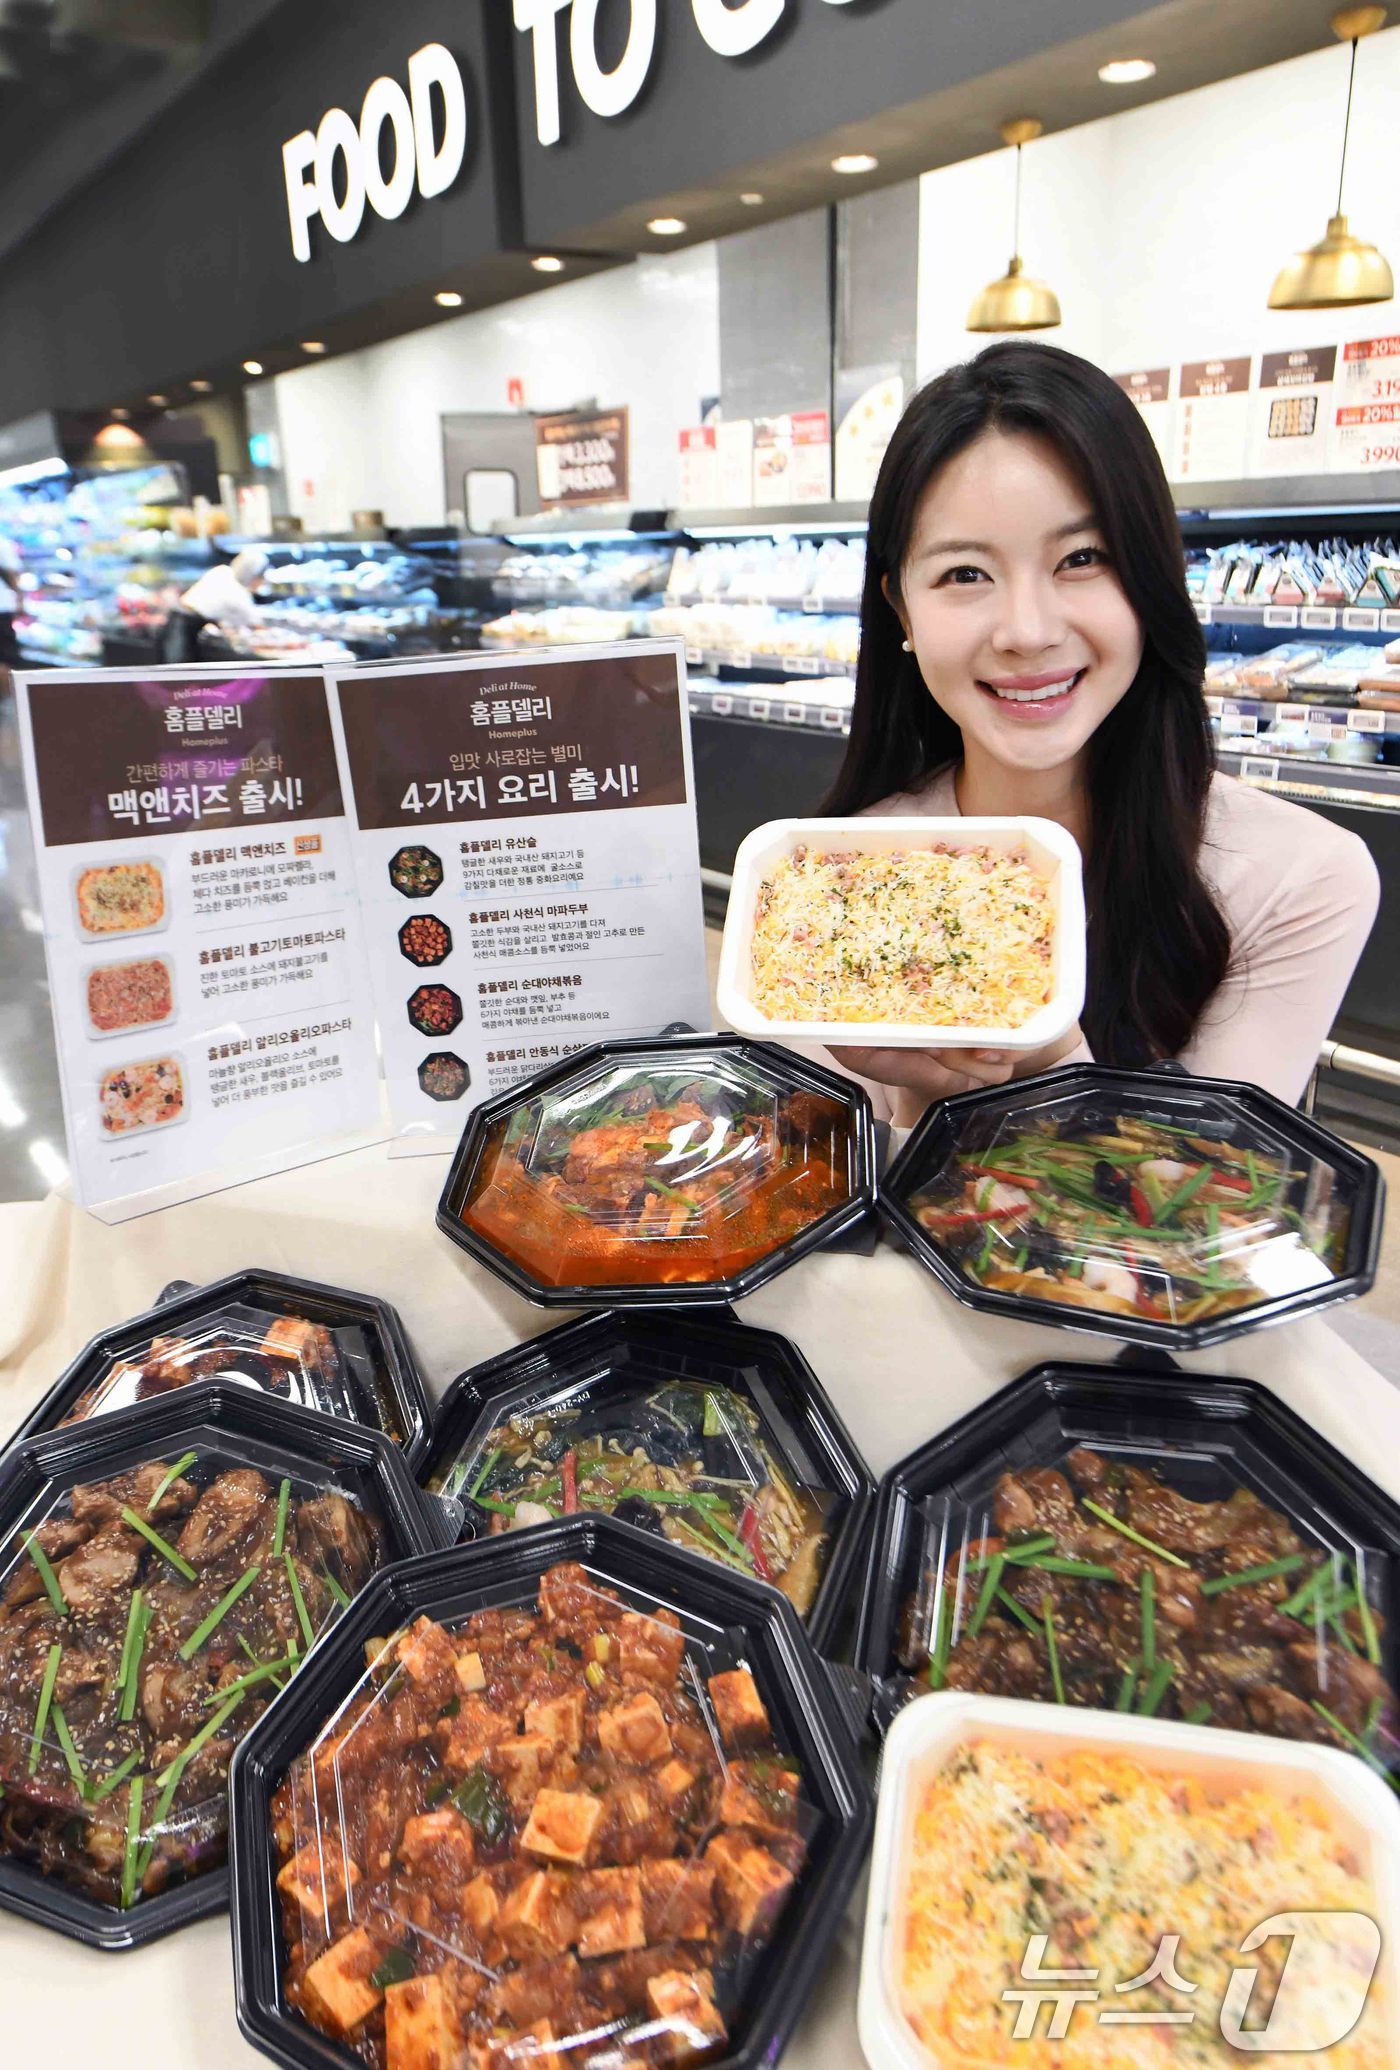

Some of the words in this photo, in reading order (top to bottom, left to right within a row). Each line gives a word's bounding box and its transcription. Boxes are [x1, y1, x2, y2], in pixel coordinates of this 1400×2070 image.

[281, 42, 467, 263] FOOD
[513, 0, 656, 146] TO
[480, 683, 497, 696] Deli
[498, 683, 508, 691] at
[509, 681, 537, 692] Home
[164, 704, 243, 733] 홈플델리
[470, 696, 552, 726] 홈플델리
[181, 736, 228, 747] Homeplus
[488, 728, 538, 739] Homeplus
[449, 752, 480, 772] 입맛
[485, 747, 547, 769] 사로잡는
[551, 743, 582, 763] 별미
[126, 761, 189, 784] 간편하게
[192, 758, 237, 779] 즐기는
[240, 754, 283, 773] 파스타
[400, 776, 486, 814] 4가지
[497, 770, 557, 804] 요리
[568, 764, 639, 802] 출시!
[108, 784, 231, 826] 맥앤치즈
[239, 776, 303, 816] 출시!
[191, 847, 237, 866] 홈플델리
[240, 841, 286, 860] 맥앤치즈
[459, 839, 502, 854] 홈플델리
[505, 836, 537, 850] 유산슬
[461, 858, 485, 868] 탱글한
[488, 856, 512, 866] 새우와
[514, 853, 539, 863] 국내산
[541, 850, 574, 860] 돼지고기
[576, 849, 584, 859] 등
[191, 870, 227, 883] 부드러운
[230, 864, 275, 880] 마카로니에
[462, 869, 484, 879] 9가지
[486, 866, 519, 877] 다채로운
[521, 864, 546, 874] 재료에
[550, 861, 583, 872] 굴소스로
[214, 883, 240, 895] 치즈를
[318, 870, 336, 882] 더해
[464, 879, 496, 891] 감칠맛을
[498, 878, 515, 887] 더한
[517, 876, 533, 886] 정통
[194, 901, 221, 914] 고소한
[224, 897, 251, 911] 풍미가
[253, 891, 288, 906] 가득해요
[468, 909, 510, 924] 홈플델리
[513, 906, 544, 920] 사천식
[547, 903, 589, 917] 마파두부
[471, 927, 494, 937] 고소한
[497, 925, 520, 935] 두부와
[522, 923, 546, 933] 국내산
[548, 919, 587, 931] 돼지고기를
[589, 918, 606, 928] 다져
[472, 938, 495, 949] 쫄깃한
[498, 935, 521, 947] 식감을
[523, 933, 547, 945] 살리고
[551, 931, 583, 942] 발효콩과
[585, 929, 601, 939] 절인
[603, 927, 627, 938] 고추로
[629, 926, 646, 936] 만든
[199, 944, 245, 965] 홈플델리
[248, 928, 345, 956] 불고기토마토파스타
[473, 948, 497, 959] 사천식
[499, 946, 538, 957] 매콤소스를
[540, 944, 556, 955] 듬뿍
[558, 942, 590, 953] 넣었어요
[200, 971, 218, 984] 진한
[220, 966, 247, 980] 토마토
[249, 960, 276, 975] 소스에
[278, 952, 328, 969] 돼지불고기를
[200, 985, 220, 999] 넣어
[222, 980, 248, 994] 고소한
[251, 975, 278, 990] 풍미가
[280, 968, 314, 983] 가득해요
[478, 980, 518, 994] 홈플델리
[521, 974, 582, 990] 순대야채볶음
[480, 998, 502, 1008] 쫄깃한
[505, 995, 528, 1006] 순대와
[550, 992, 566, 1002] 부추
[568, 991, 576, 1000] 등
[481, 1009, 501, 1019] 6가지
[503, 1006, 526, 1017] 야채를
[529, 1005, 544, 1015] 듬뿍
[546, 1003, 562, 1013] 넣고
[481, 1019, 514, 1030] 매콤하게
[515, 1017, 539, 1027] 볶아낸
[541, 1011, 610, 1025] 순대야채볶음이에요
[208, 1038, 252, 1061] 홈플델리
[255, 1018, 352, 1051] 알리오올리오파스타
[238, 1053, 290, 1073] 알리오올리오
[292, 1046, 317, 1060] 소스에
[307, 1055, 340, 1070] 토마토를
[486, 1048, 526, 1062] 홈플델리
[529, 1045, 559, 1058] 안동식
[488, 1065, 518, 1076] 부드러운
[211, 1094, 230, 1108] 넣어
[231, 1091, 241, 1103] 더
[271, 1080, 288, 1093] 맛을
[309, 1073, 318, 1084] 수
[319, 1067, 343, 1081] 있어요
[488, 1077, 509, 1086] 6가지
